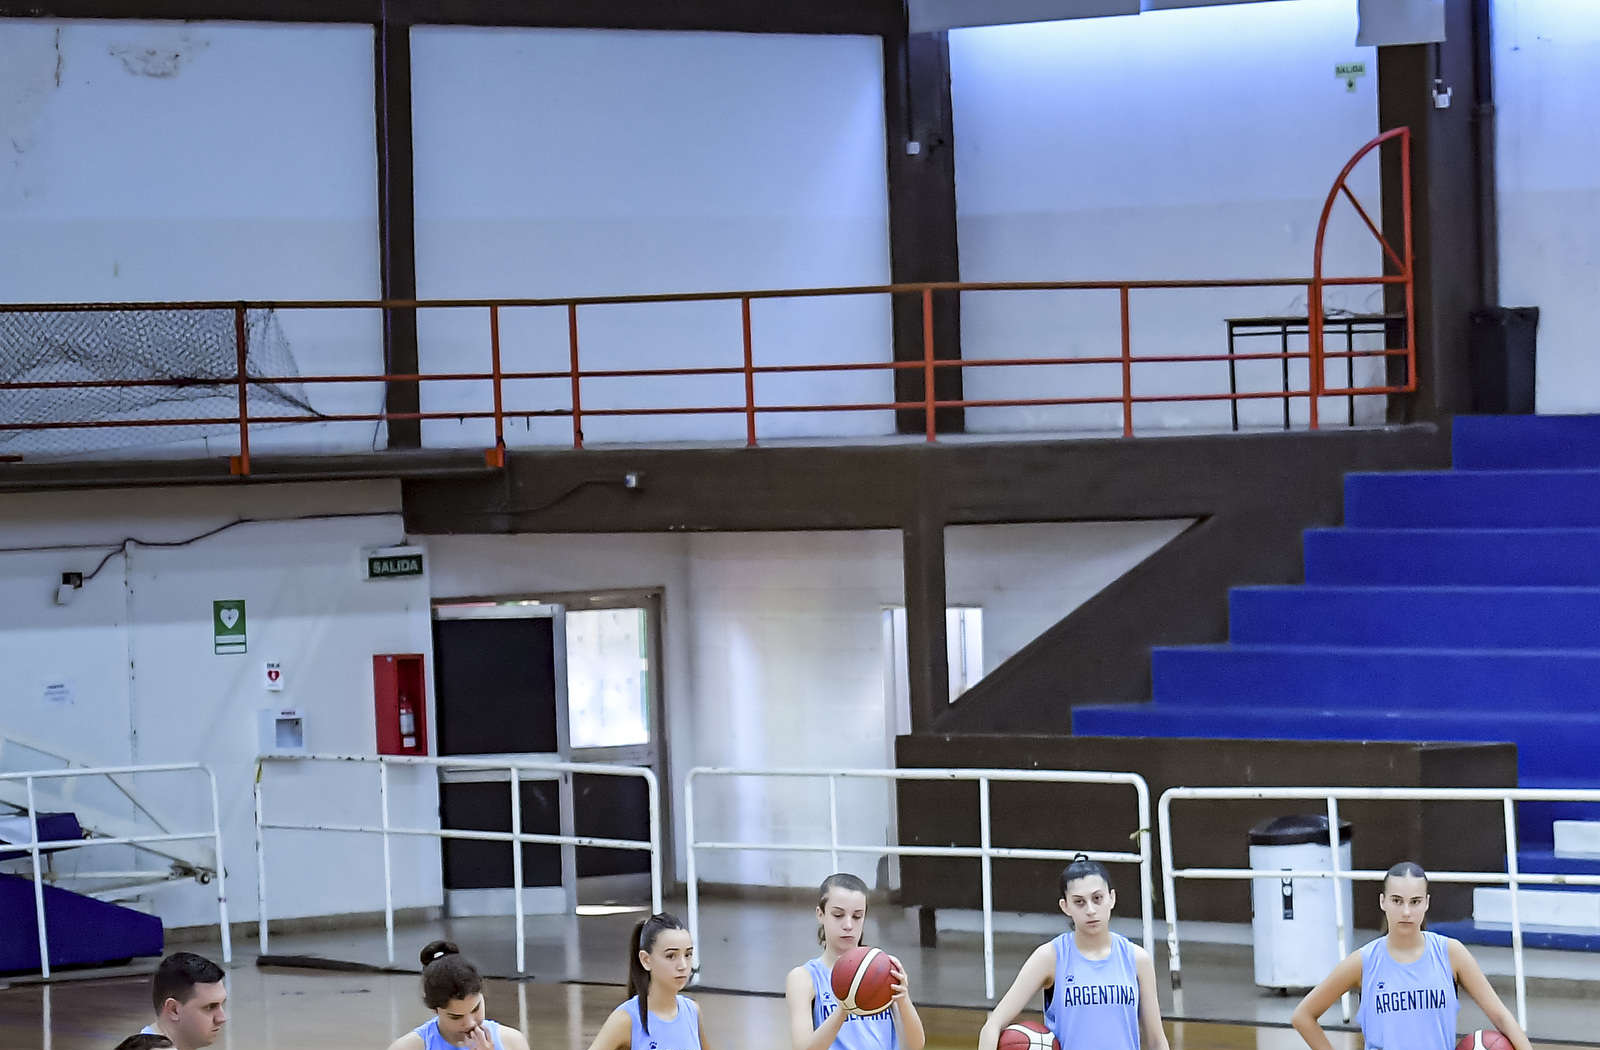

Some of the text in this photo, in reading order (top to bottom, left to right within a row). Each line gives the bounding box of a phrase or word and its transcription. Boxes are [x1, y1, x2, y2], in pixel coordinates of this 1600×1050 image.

[372, 560, 418, 573] SALIDA
[1065, 985, 1135, 1007] ARGENTINA
[1376, 989, 1446, 1014] ARGENTINA
